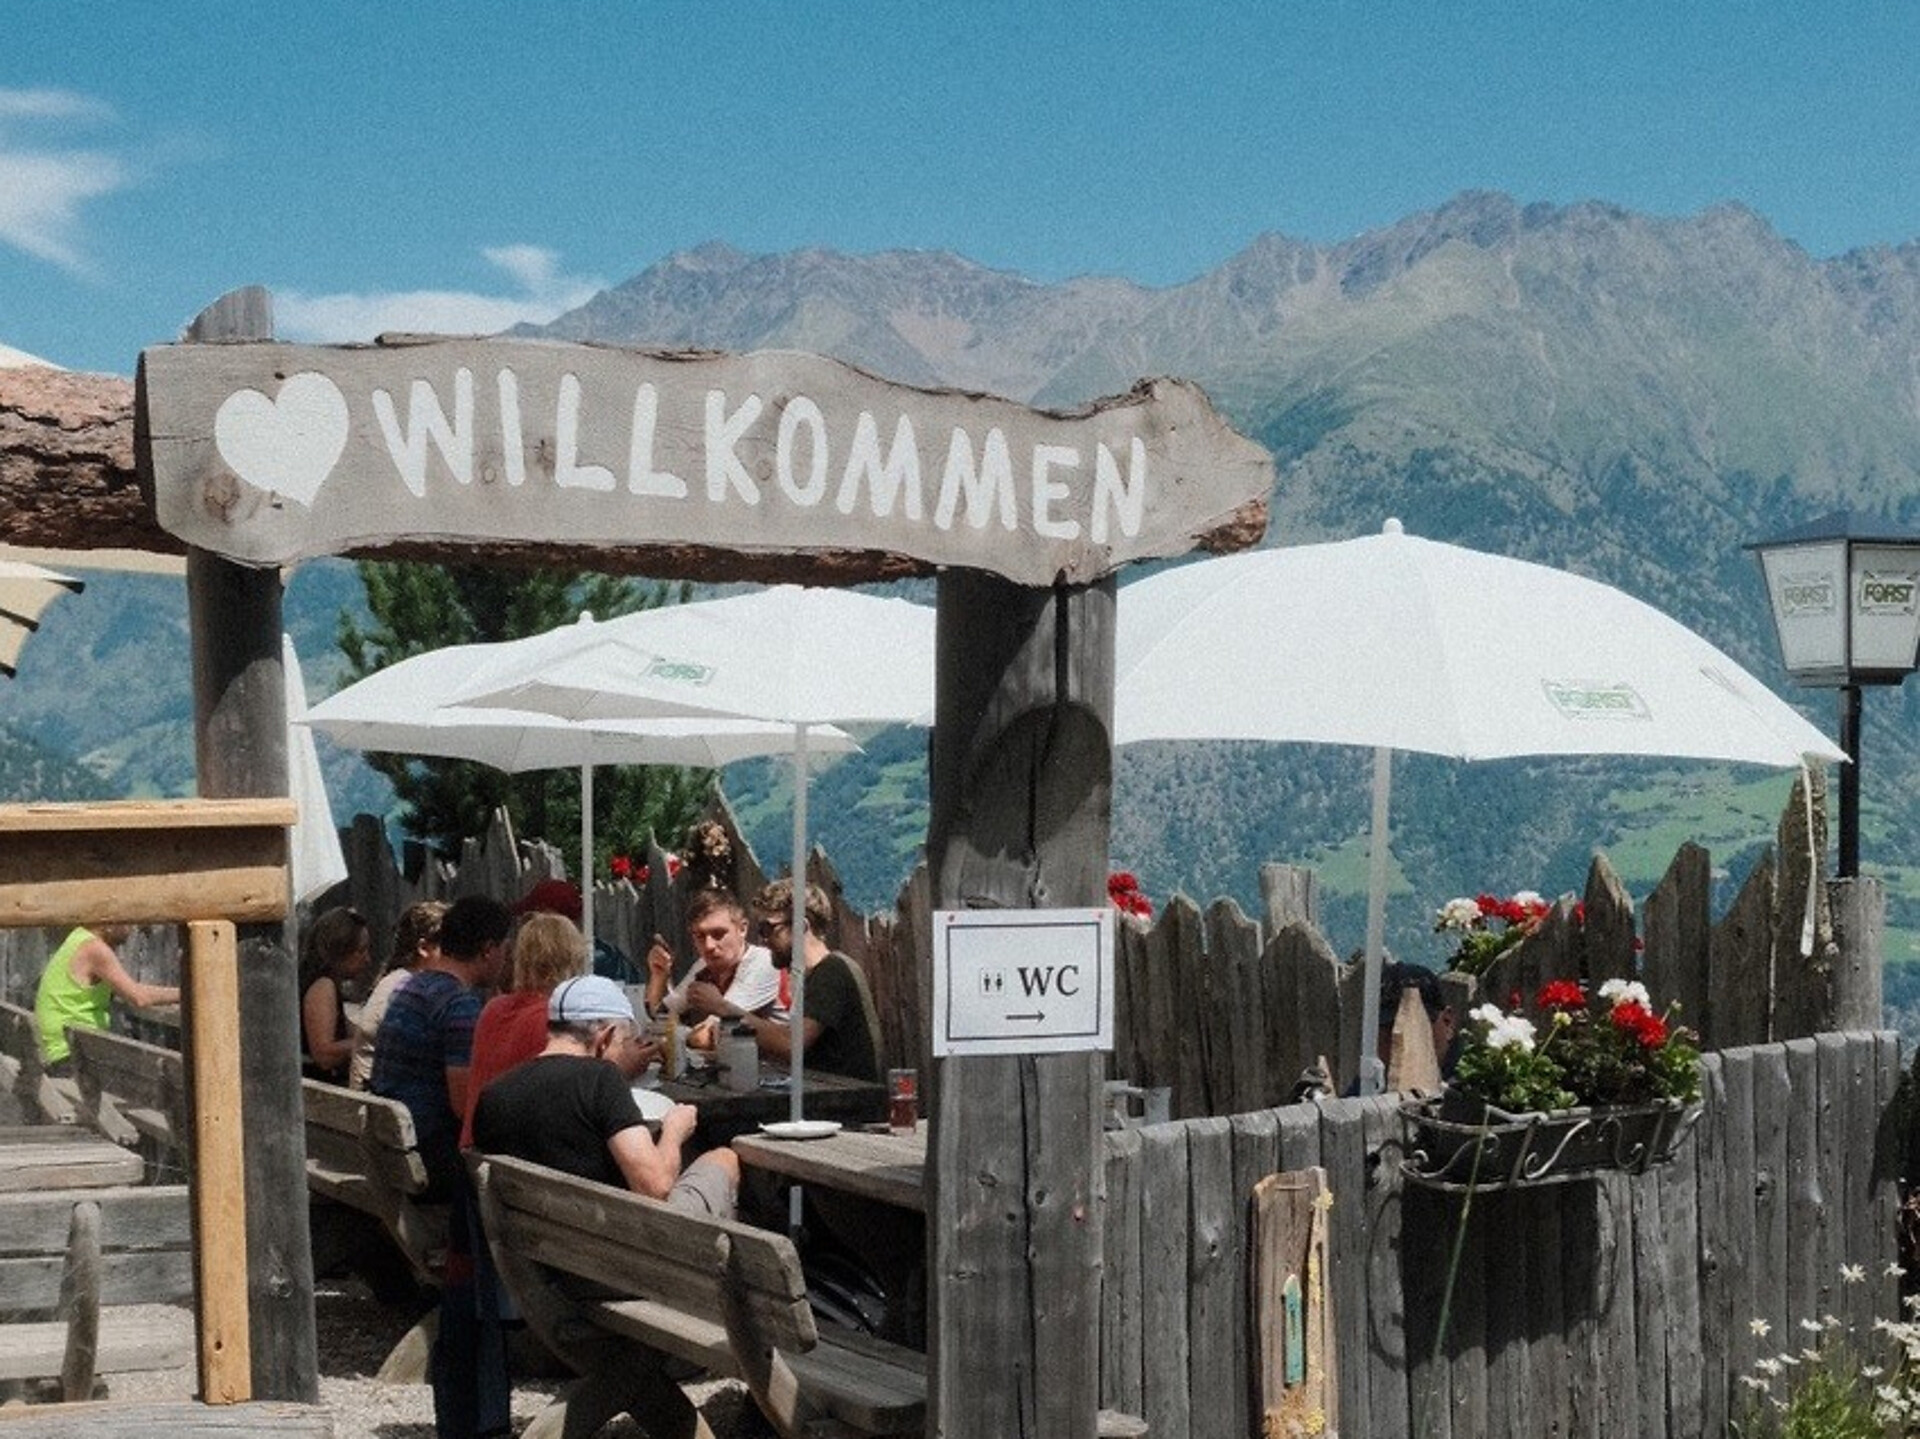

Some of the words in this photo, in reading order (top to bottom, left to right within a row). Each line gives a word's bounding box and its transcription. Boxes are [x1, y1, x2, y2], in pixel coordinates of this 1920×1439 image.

[372, 367, 1146, 545] WILLKOMMEN
[1864, 583, 1914, 603] FORST
[1018, 965, 1079, 997] WC
